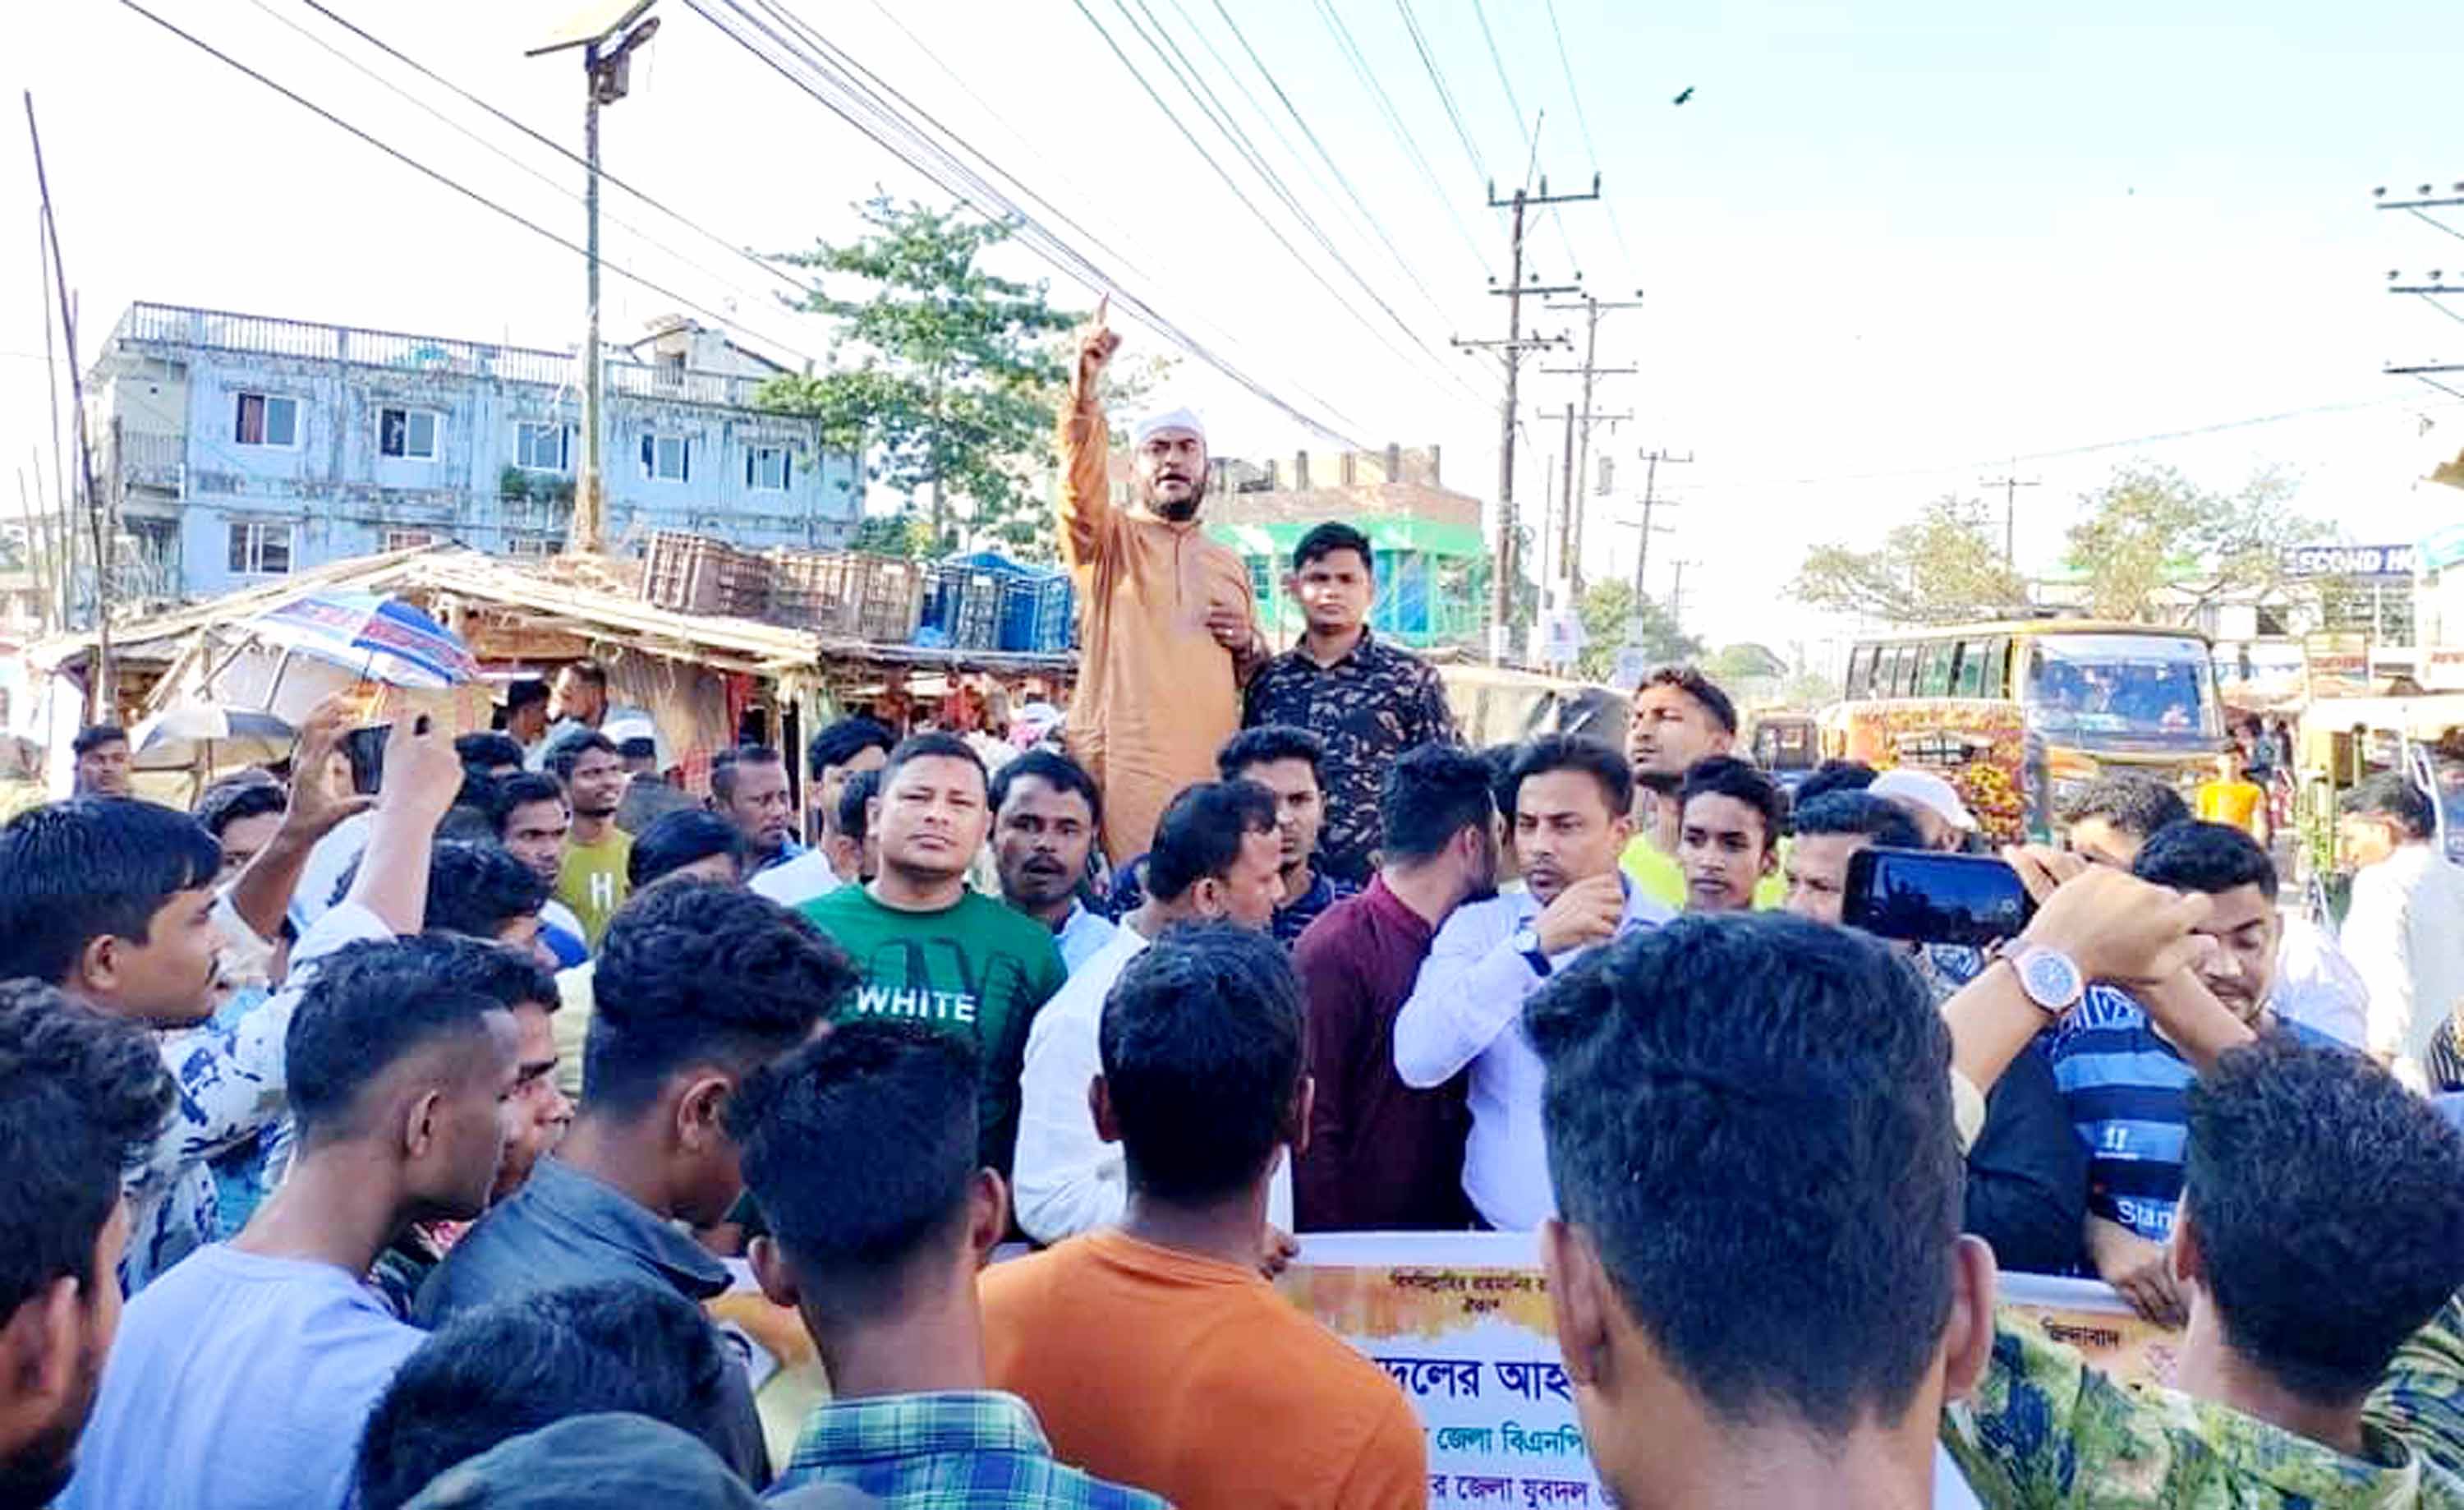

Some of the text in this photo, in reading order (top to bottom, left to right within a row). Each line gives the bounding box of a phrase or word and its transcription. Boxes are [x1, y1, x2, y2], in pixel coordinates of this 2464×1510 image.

[591, 872, 614, 909] H
[857, 987, 976, 1022] WHITE
[1372, 1357, 1572, 1403] দলের আহ
[1437, 1420, 1585, 1457] জেলা বিএনপি
[1455, 1475, 1514, 1503] জেলা
